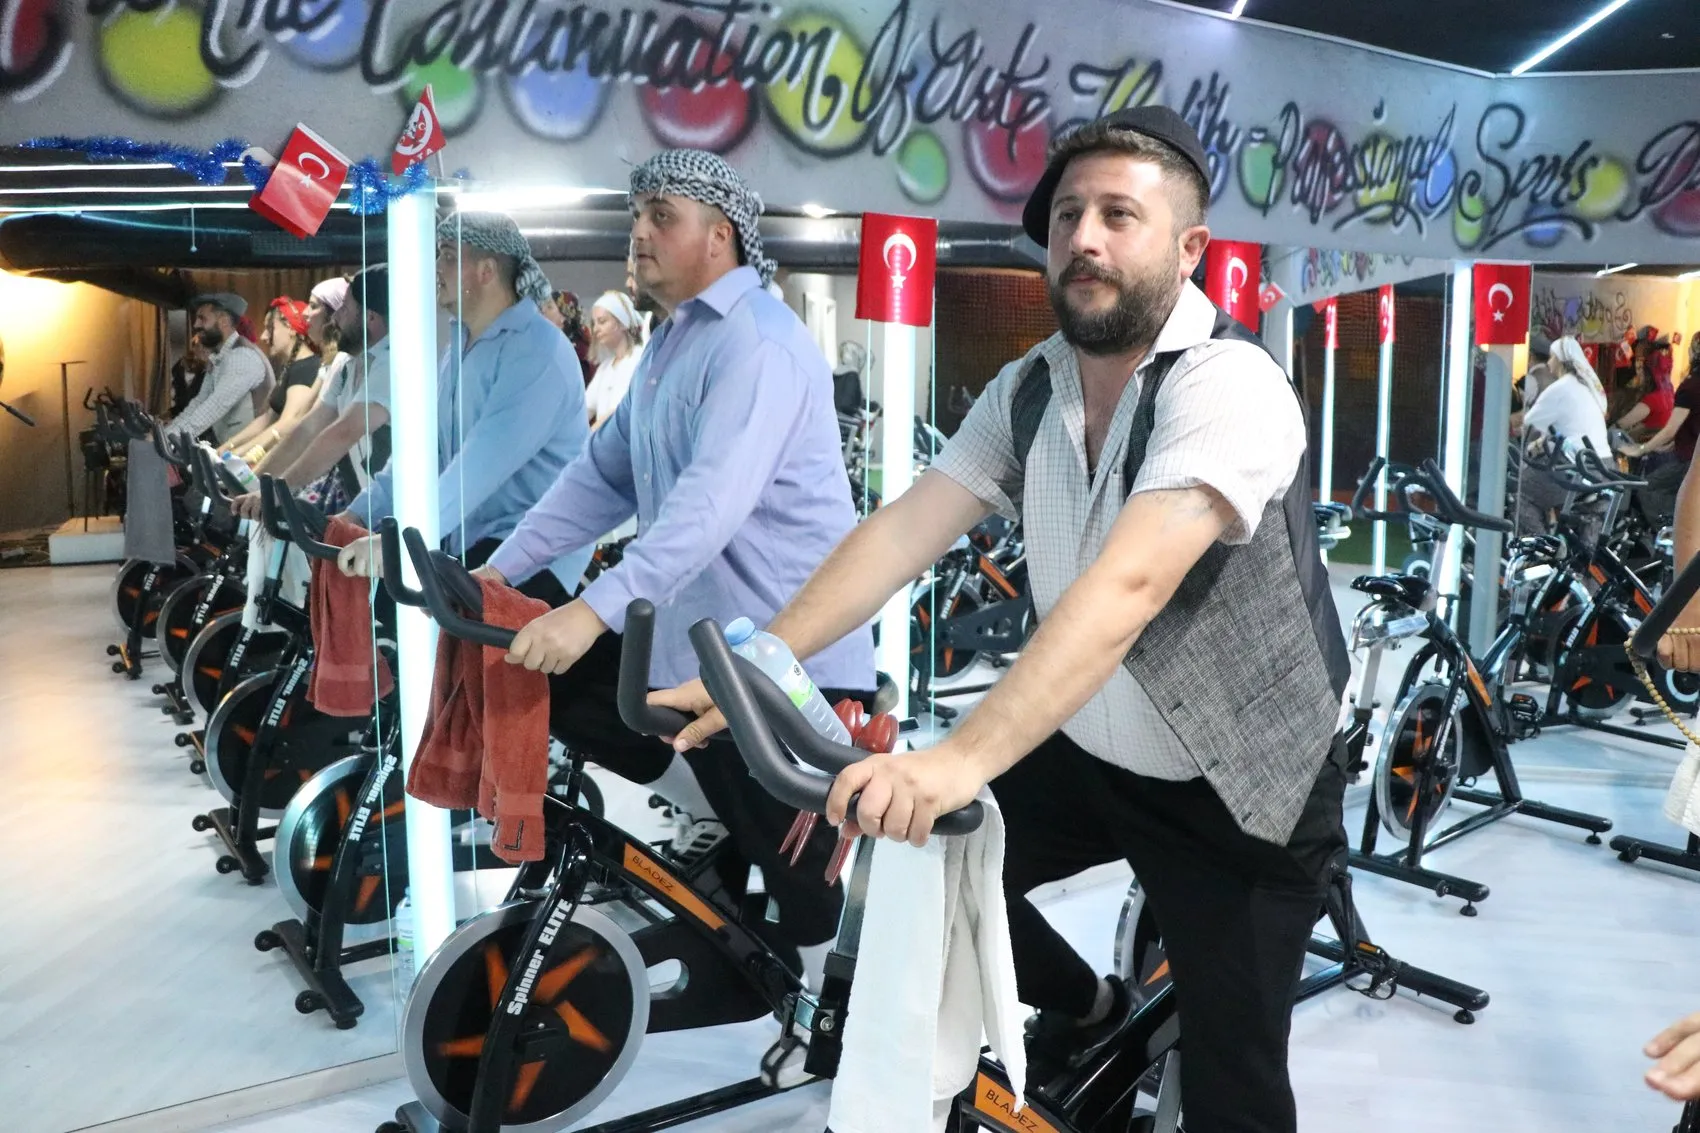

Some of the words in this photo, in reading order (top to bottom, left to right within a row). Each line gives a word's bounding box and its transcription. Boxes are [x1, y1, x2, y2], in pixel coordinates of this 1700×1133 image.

[632, 855, 674, 892] BLADEZ
[506, 948, 545, 1016] Spinner
[538, 898, 573, 946] ELITE
